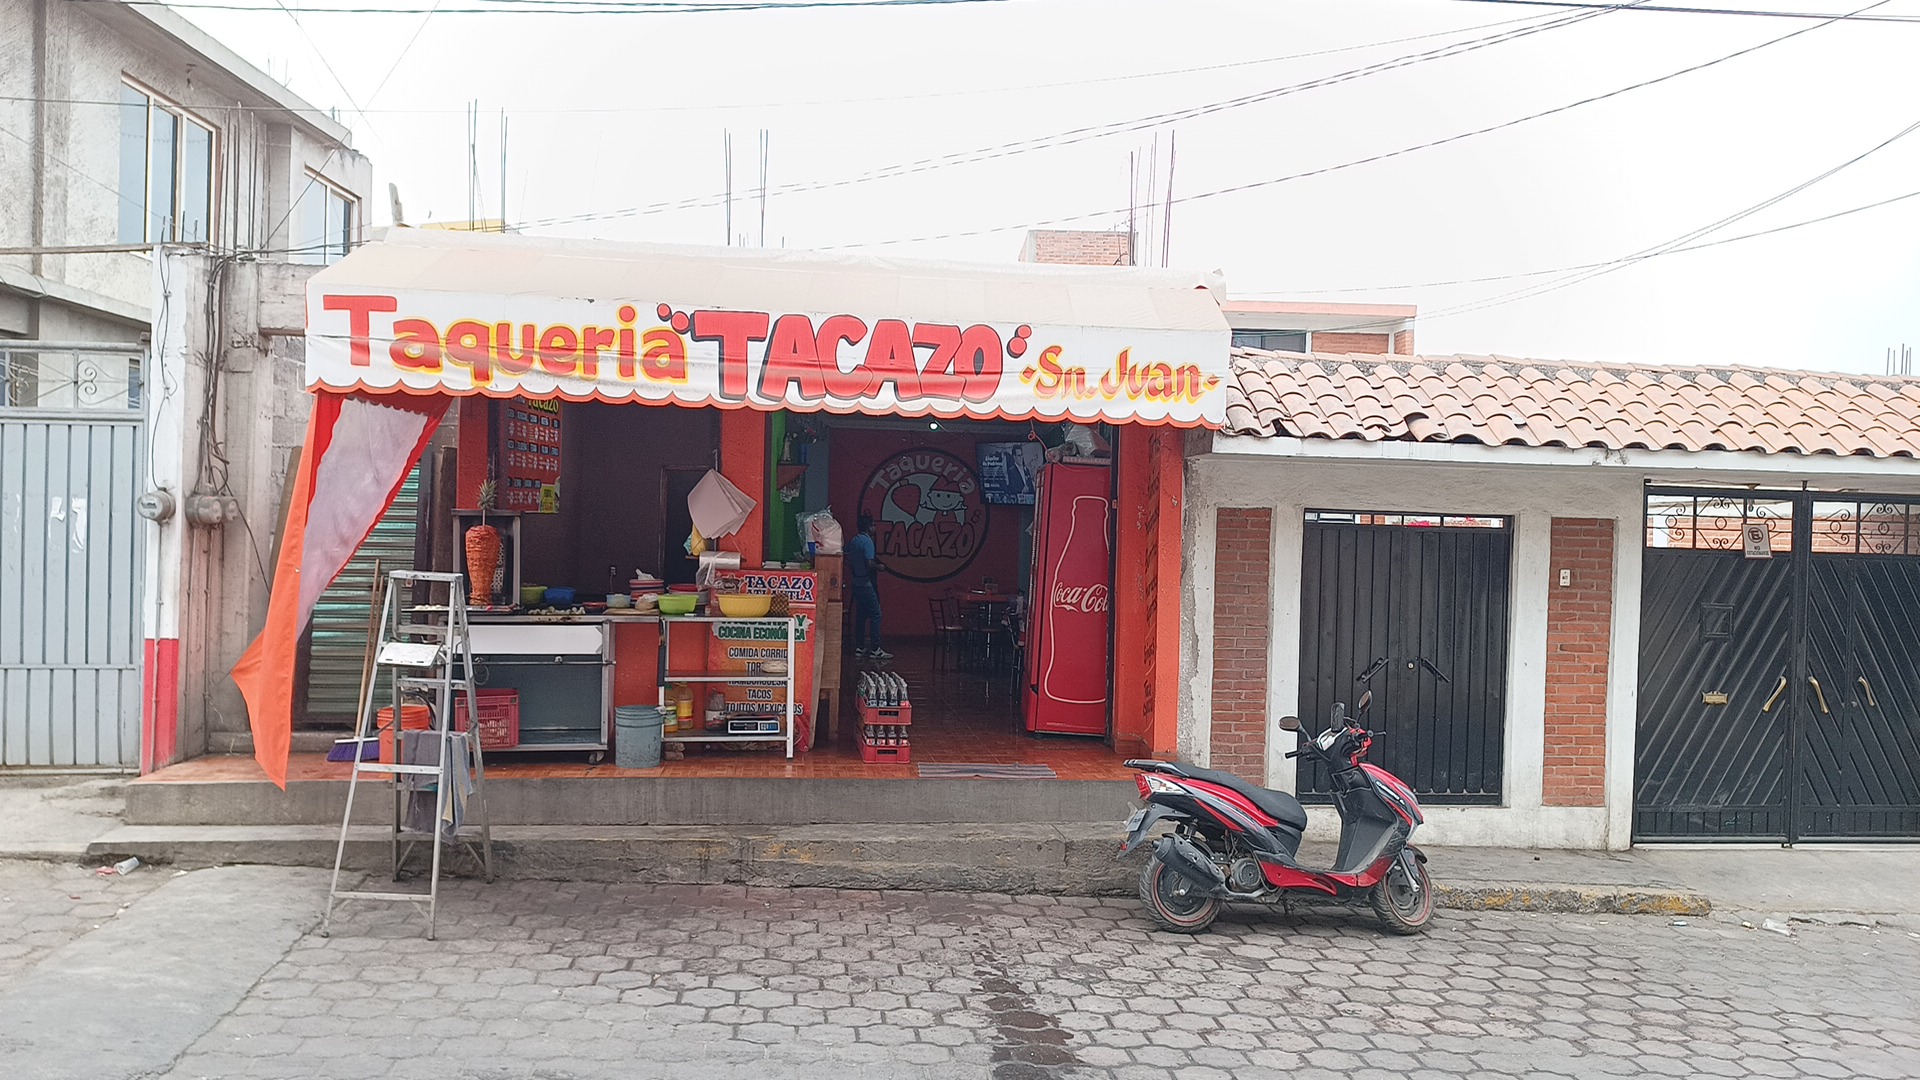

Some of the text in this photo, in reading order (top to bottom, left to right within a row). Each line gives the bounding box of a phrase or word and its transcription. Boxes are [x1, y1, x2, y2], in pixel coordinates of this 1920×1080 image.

[322, 294, 1206, 405] Taqueria TACAZO Sn. Juan
[869, 455, 976, 495] Taqueria
[874, 520, 975, 559] TACAZO
[744, 575, 814, 590] TACAZO
[1053, 581, 1109, 613] Coca-Col
[718, 626, 752, 639] COCINA
[728, 647, 788, 659] COMIDA CORRID
[747, 689, 772, 699] TACOS
[726, 702, 803, 714] TOJITOS MEXICAOS
